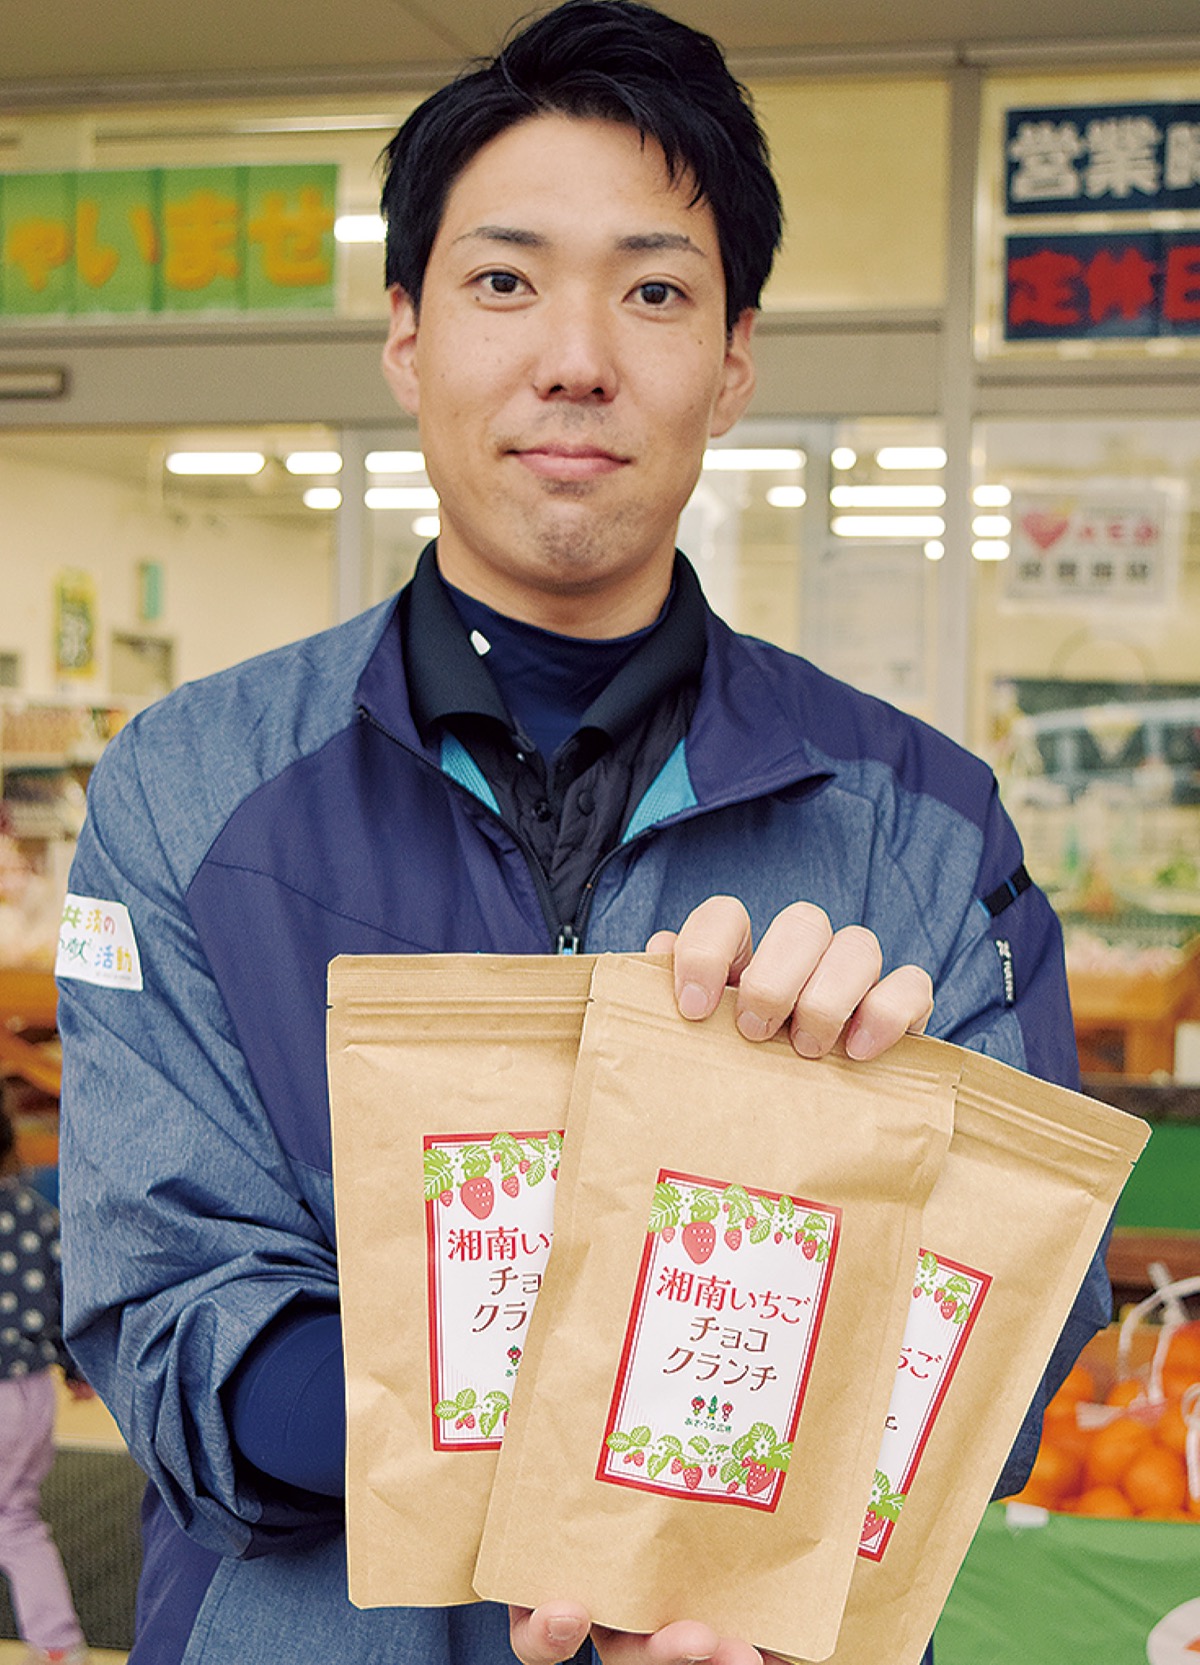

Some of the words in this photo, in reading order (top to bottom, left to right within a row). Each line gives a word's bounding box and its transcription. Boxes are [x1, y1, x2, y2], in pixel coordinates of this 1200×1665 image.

[447, 1225, 554, 1262] 湘南い
[488, 1266, 542, 1296] チョ
[655, 1265, 810, 1324] 湘南いちご
[471, 1301, 528, 1333] クラ
[690, 1316, 769, 1354] チョコ
[661, 1346, 778, 1392] クランチ
